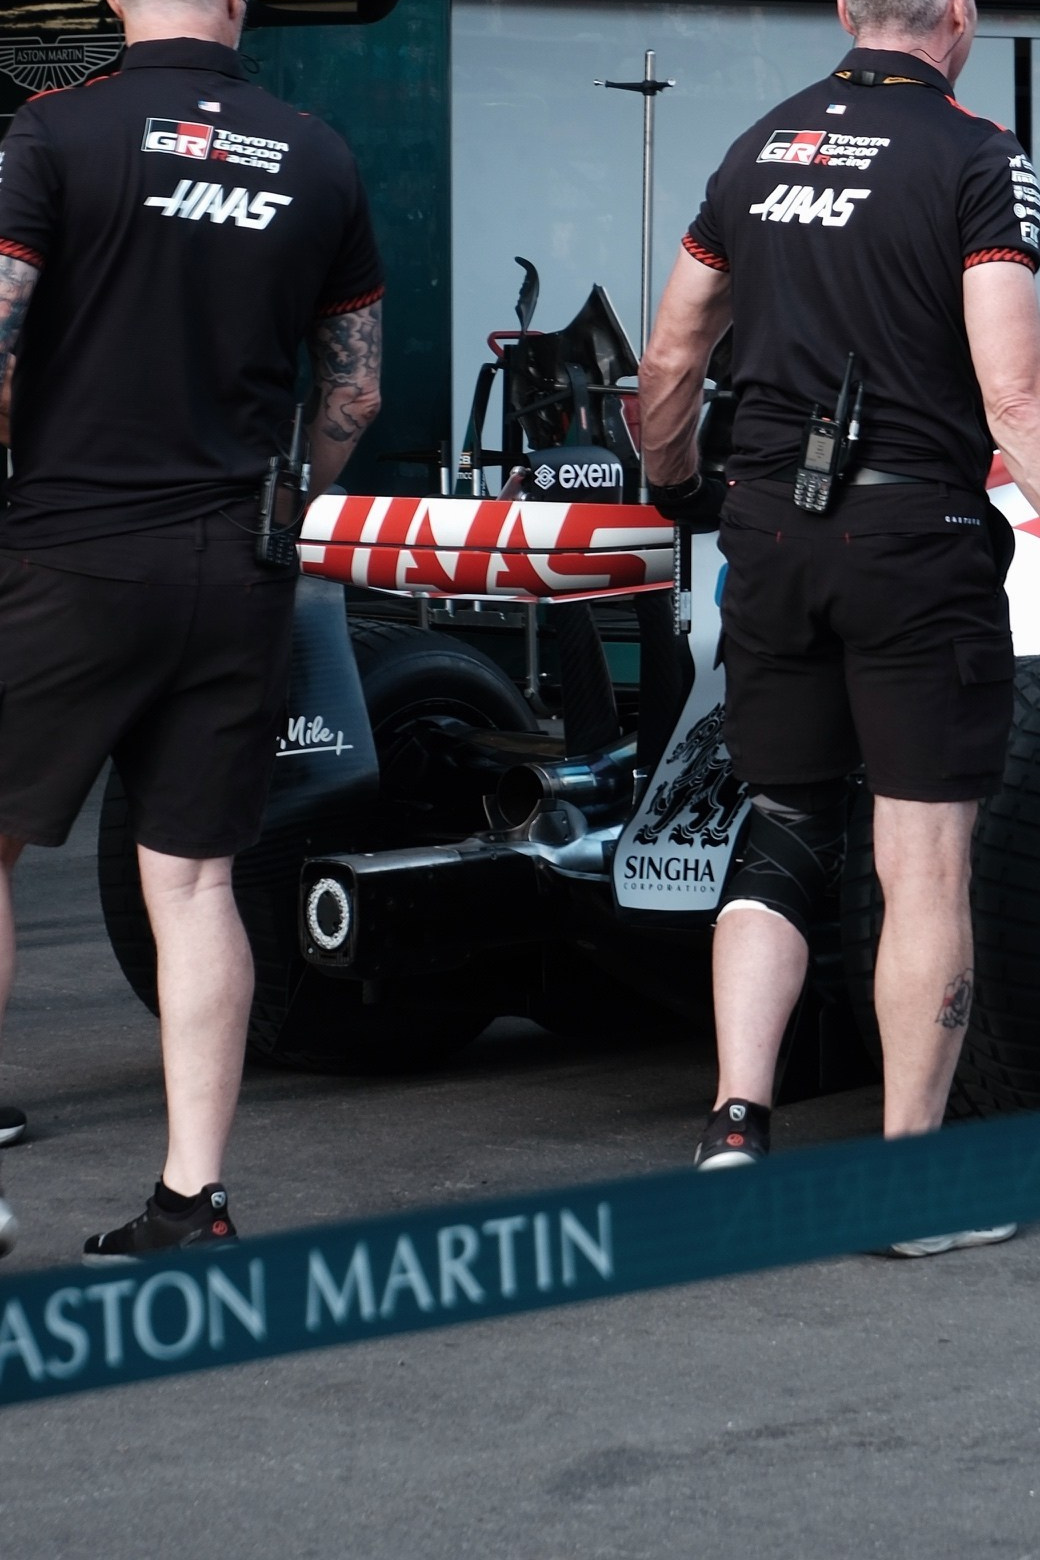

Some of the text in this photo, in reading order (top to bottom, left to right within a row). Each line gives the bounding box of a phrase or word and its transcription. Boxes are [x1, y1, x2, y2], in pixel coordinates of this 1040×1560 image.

[16, 47, 83, 63] ASTON MARTIN
[145, 131, 207, 158] GR
[212, 138, 283, 161] GAZOO
[215, 129, 290, 152] TOYOTA
[820, 144, 879, 157] GAZOO
[827, 133, 891, 147] TOYOTA
[210, 150, 280, 174] Racing
[814, 154, 872, 170] Racing
[143, 179, 294, 230] HAAS
[749, 183, 872, 227] HAAS
[624, 855, 715, 882] SINGHA
[623, 882, 716, 893] CORPORATION
[0, 1202, 615, 1382] ASTON MARTIN
